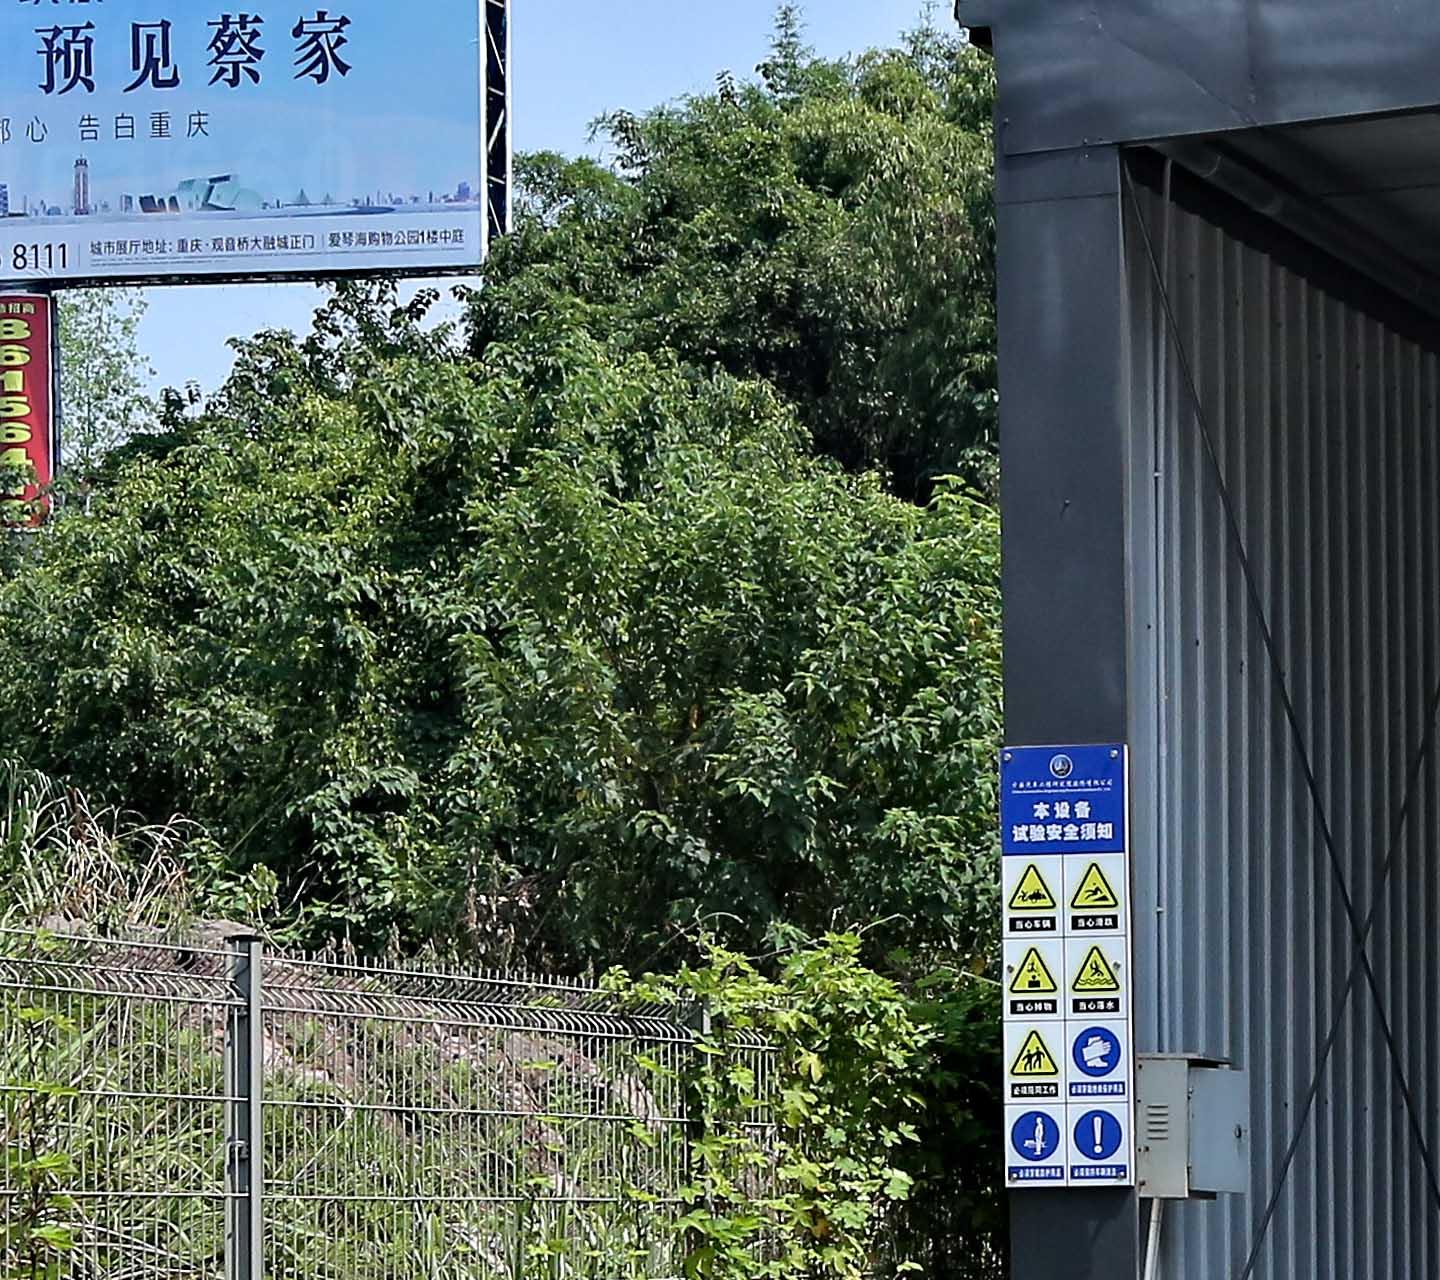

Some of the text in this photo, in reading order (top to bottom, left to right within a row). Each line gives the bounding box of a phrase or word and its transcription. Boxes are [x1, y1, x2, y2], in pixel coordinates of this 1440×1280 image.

[34, 9, 354, 95] 预见蔡家
[78, 110, 212, 141] 告白重庆
[12, 242, 68, 270] 8111
[1033, 800, 1091, 820] 本设备
[1012, 823, 1113, 842] 试验安全须知
